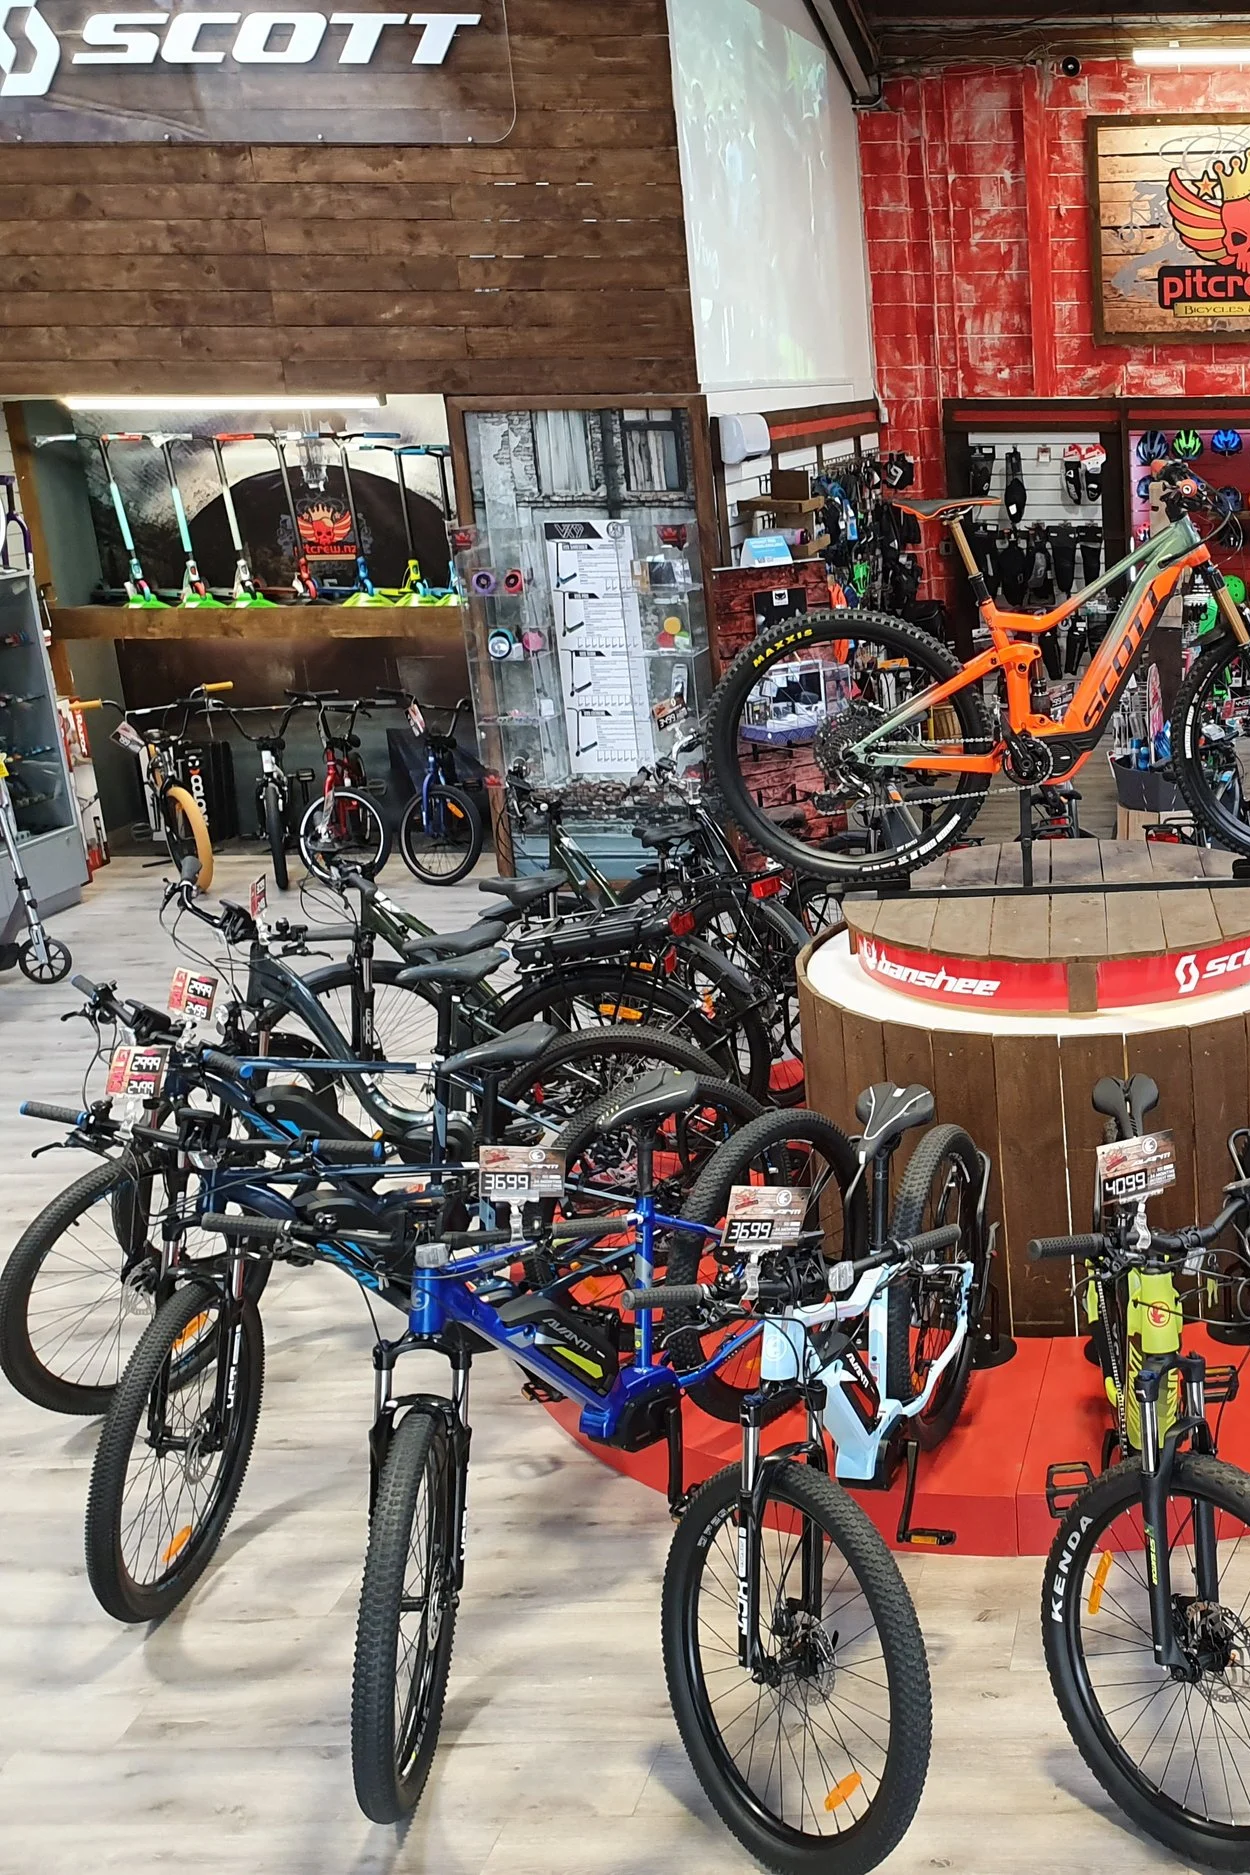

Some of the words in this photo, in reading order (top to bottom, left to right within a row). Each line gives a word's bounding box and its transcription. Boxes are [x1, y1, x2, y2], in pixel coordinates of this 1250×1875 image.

[72, 12, 482, 65] SCOTT
[1183, 303, 1245, 315] BICYCLES
[753, 629, 813, 668] MAXXIS
[74, 710, 87, 757] Razor
[877, 951, 1001, 996] banshee
[131, 1056, 160, 1072] 2999
[484, 1173, 529, 1191] 3699
[1105, 1171, 1146, 1195] 4099
[728, 1222, 772, 1240] 3699
[542, 1318, 592, 1352] AVANTI
[846, 1352, 869, 1389] AVANTI
[1051, 1515, 1094, 1623] KENDA
